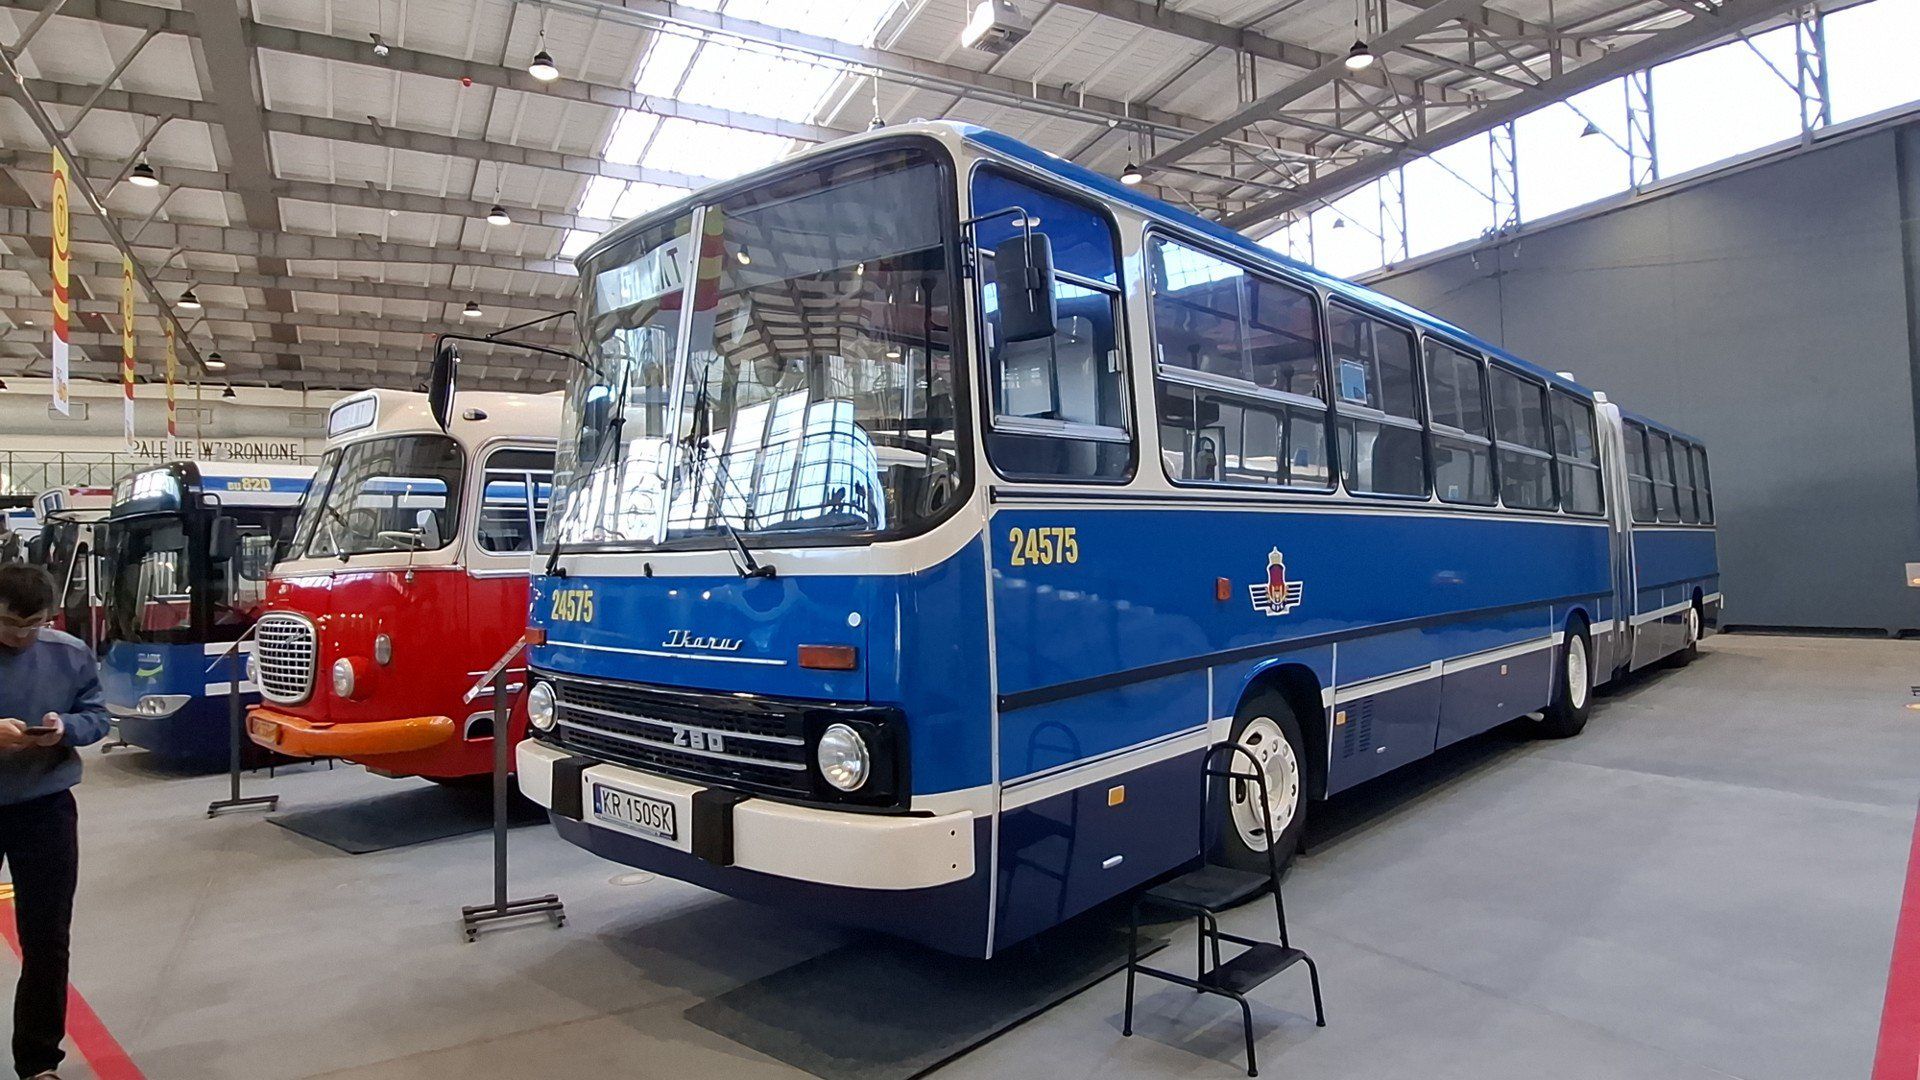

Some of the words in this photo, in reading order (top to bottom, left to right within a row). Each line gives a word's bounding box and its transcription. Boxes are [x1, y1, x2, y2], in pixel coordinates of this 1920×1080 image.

[1009, 527, 1078, 566] 24575
[551, 589, 593, 622] 24575
[662, 629, 743, 651] Ikarus
[672, 725, 724, 752] 280
[602, 790, 622, 818] KR
[627, 798, 672, 832] 150SK
